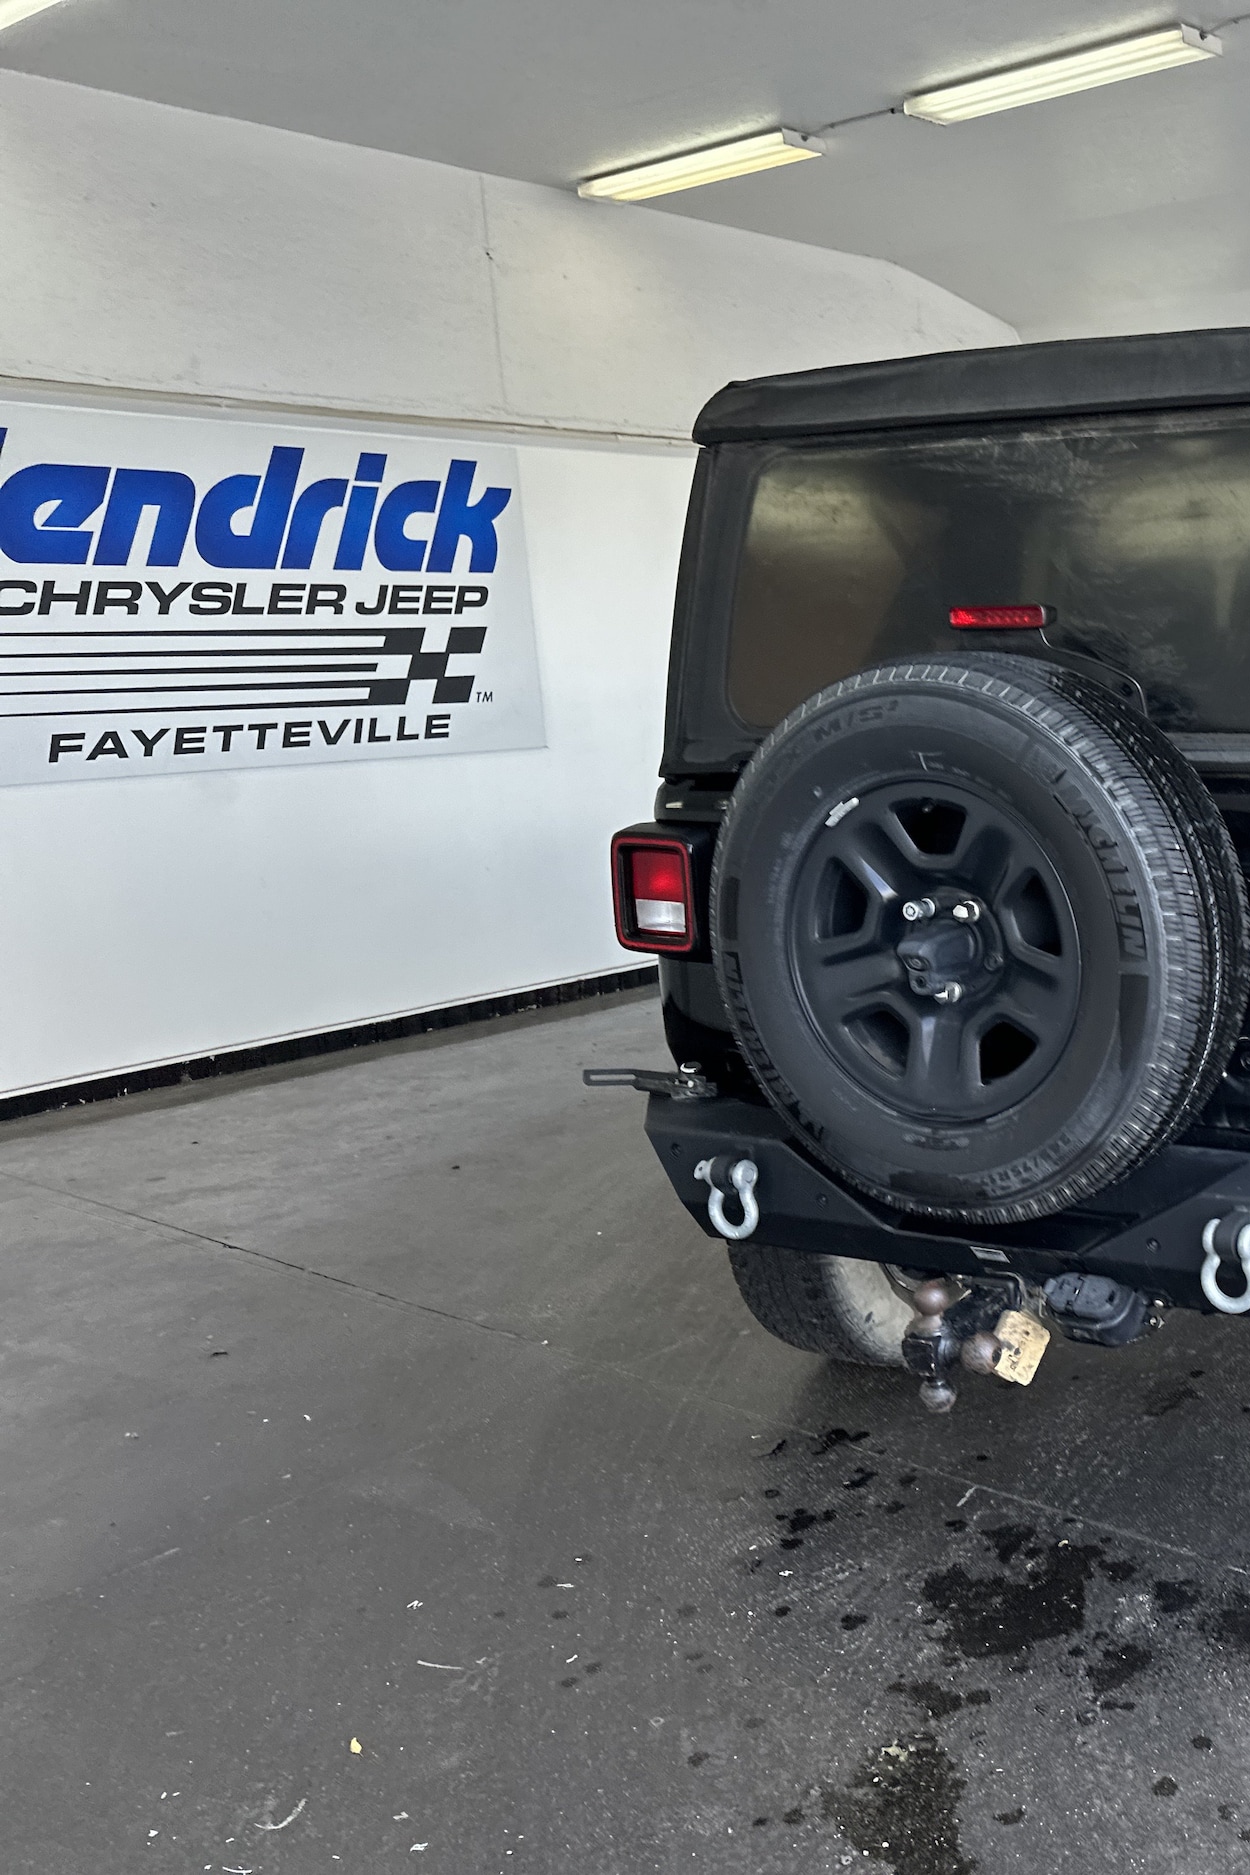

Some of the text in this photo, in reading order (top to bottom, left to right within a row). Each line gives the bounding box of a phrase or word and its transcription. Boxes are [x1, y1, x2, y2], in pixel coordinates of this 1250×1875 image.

[0, 427, 511, 573] endrick
[0, 580, 489, 616] CHRYSLER JEEP
[476, 691, 493, 703] TM
[48, 713, 452, 764] FAYETTEVILLE
